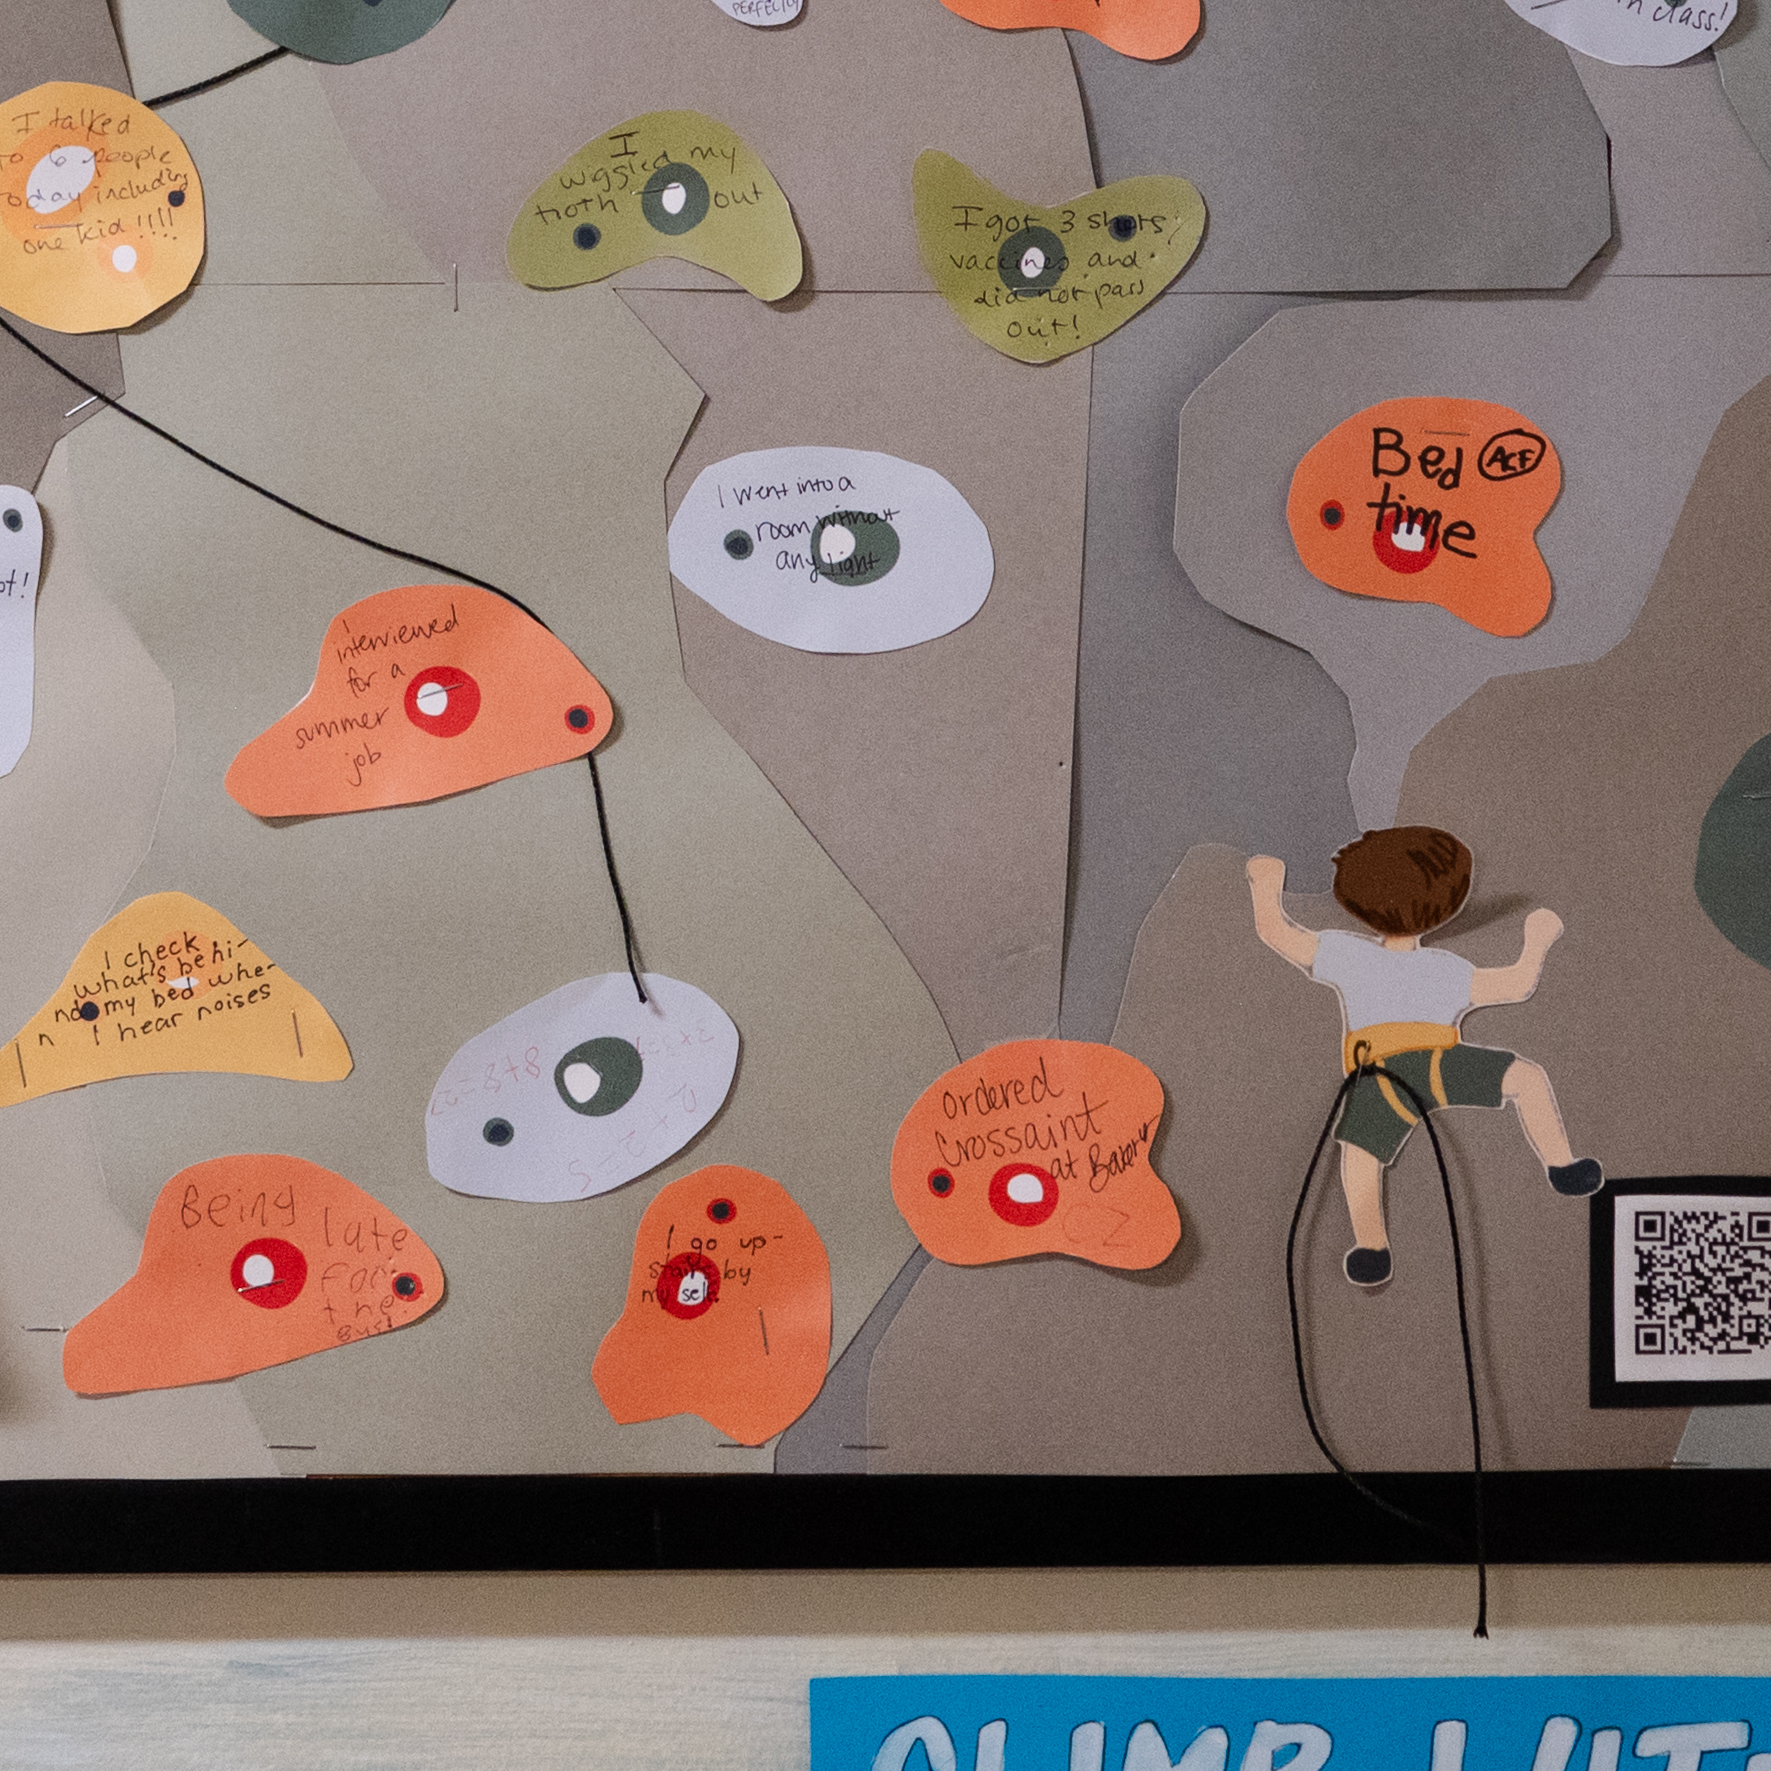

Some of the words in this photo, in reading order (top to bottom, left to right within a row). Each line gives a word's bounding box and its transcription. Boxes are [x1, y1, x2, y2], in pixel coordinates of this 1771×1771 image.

[1652, 1, 1729, 32] class!
[11, 110, 41, 135] I
[48, 107, 131, 142] talked
[82, 144, 172, 178] people
[689, 146, 737, 175] my
[93, 167, 189, 205] including
[713, 181, 764, 208] out
[985, 214, 1041, 242] got
[22, 237, 63, 255] one
[1088, 249, 1142, 269] and
[1371, 426, 1464, 491] Bed
[1485, 444, 1536, 473] ACF
[732, 482, 789, 507] went
[796, 477, 834, 496] into
[755, 519, 811, 543] room
[1365, 481, 1478, 560] time
[775, 549, 820, 584] any
[346, 666, 378, 700] for
[294, 707, 390, 751] summer
[344, 744, 383, 788] job
[123, 930, 201, 971] check
[73, 959, 167, 1000] what's
[104, 995, 137, 1016] my
[152, 979, 195, 1009] bed
[117, 1011, 184, 1043] hear
[197, 982, 272, 1021] noises
